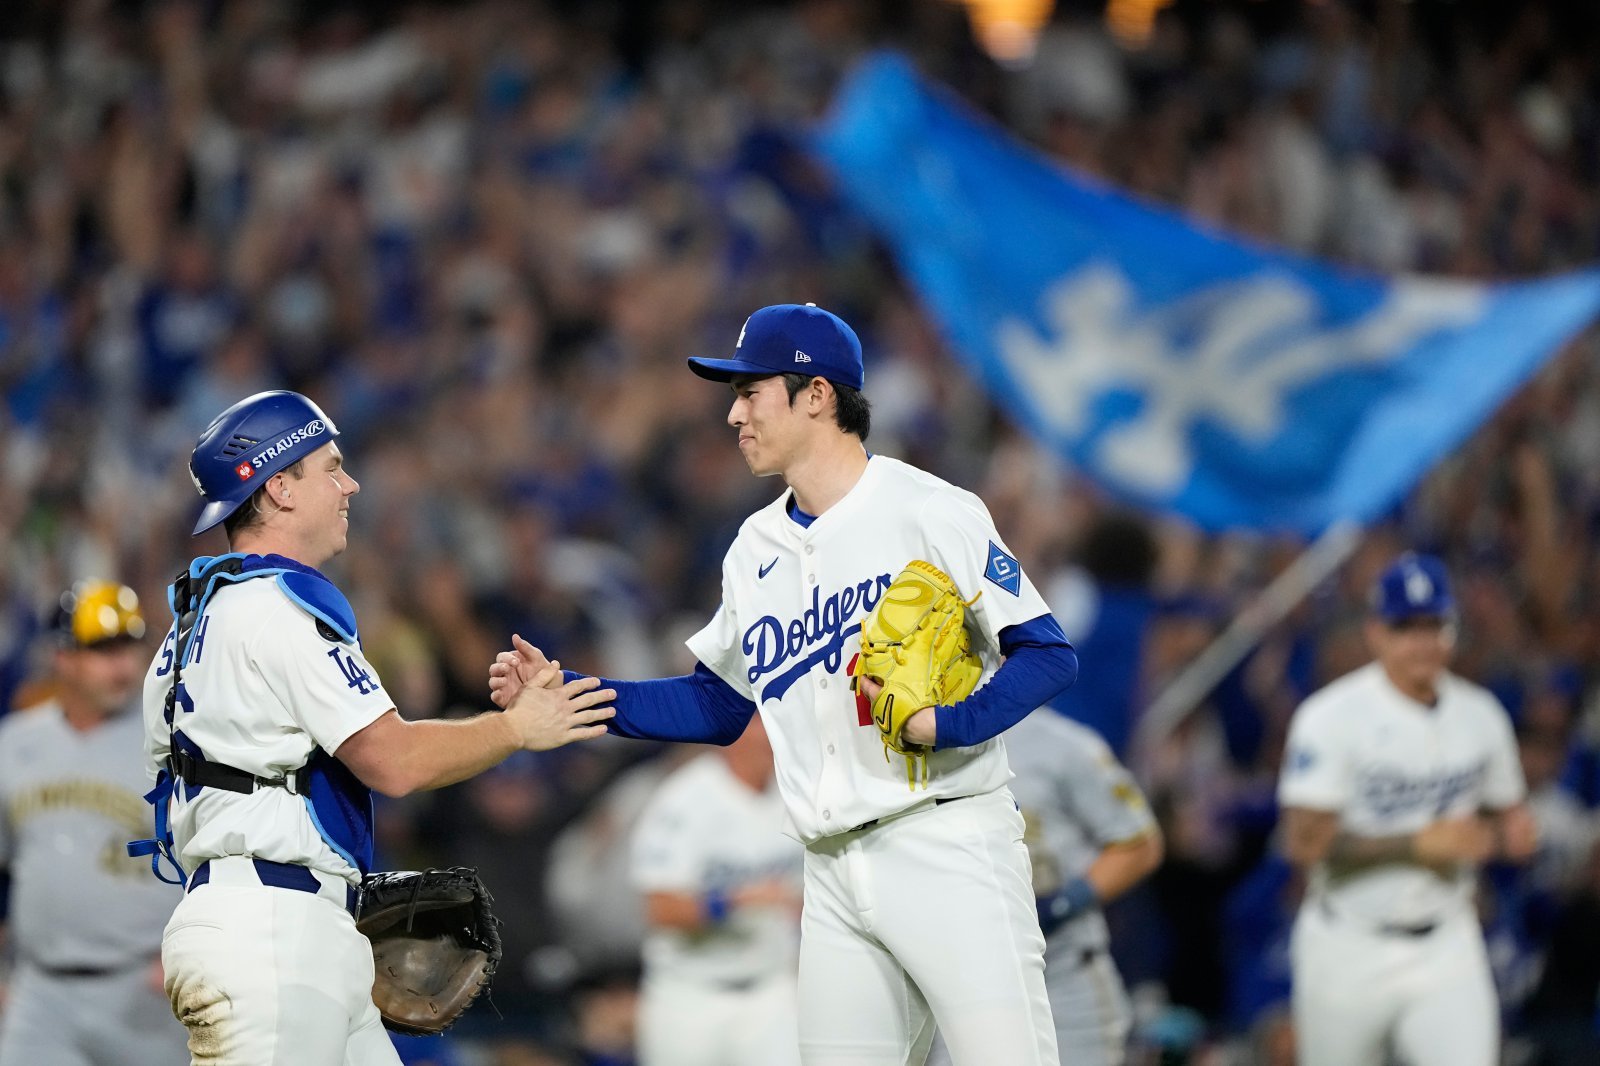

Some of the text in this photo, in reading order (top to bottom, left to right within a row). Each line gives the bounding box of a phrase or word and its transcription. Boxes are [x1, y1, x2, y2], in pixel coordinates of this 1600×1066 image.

[252, 428, 307, 468] STRAUSS
[993, 555, 1010, 575] G
[327, 646, 379, 695] LA
